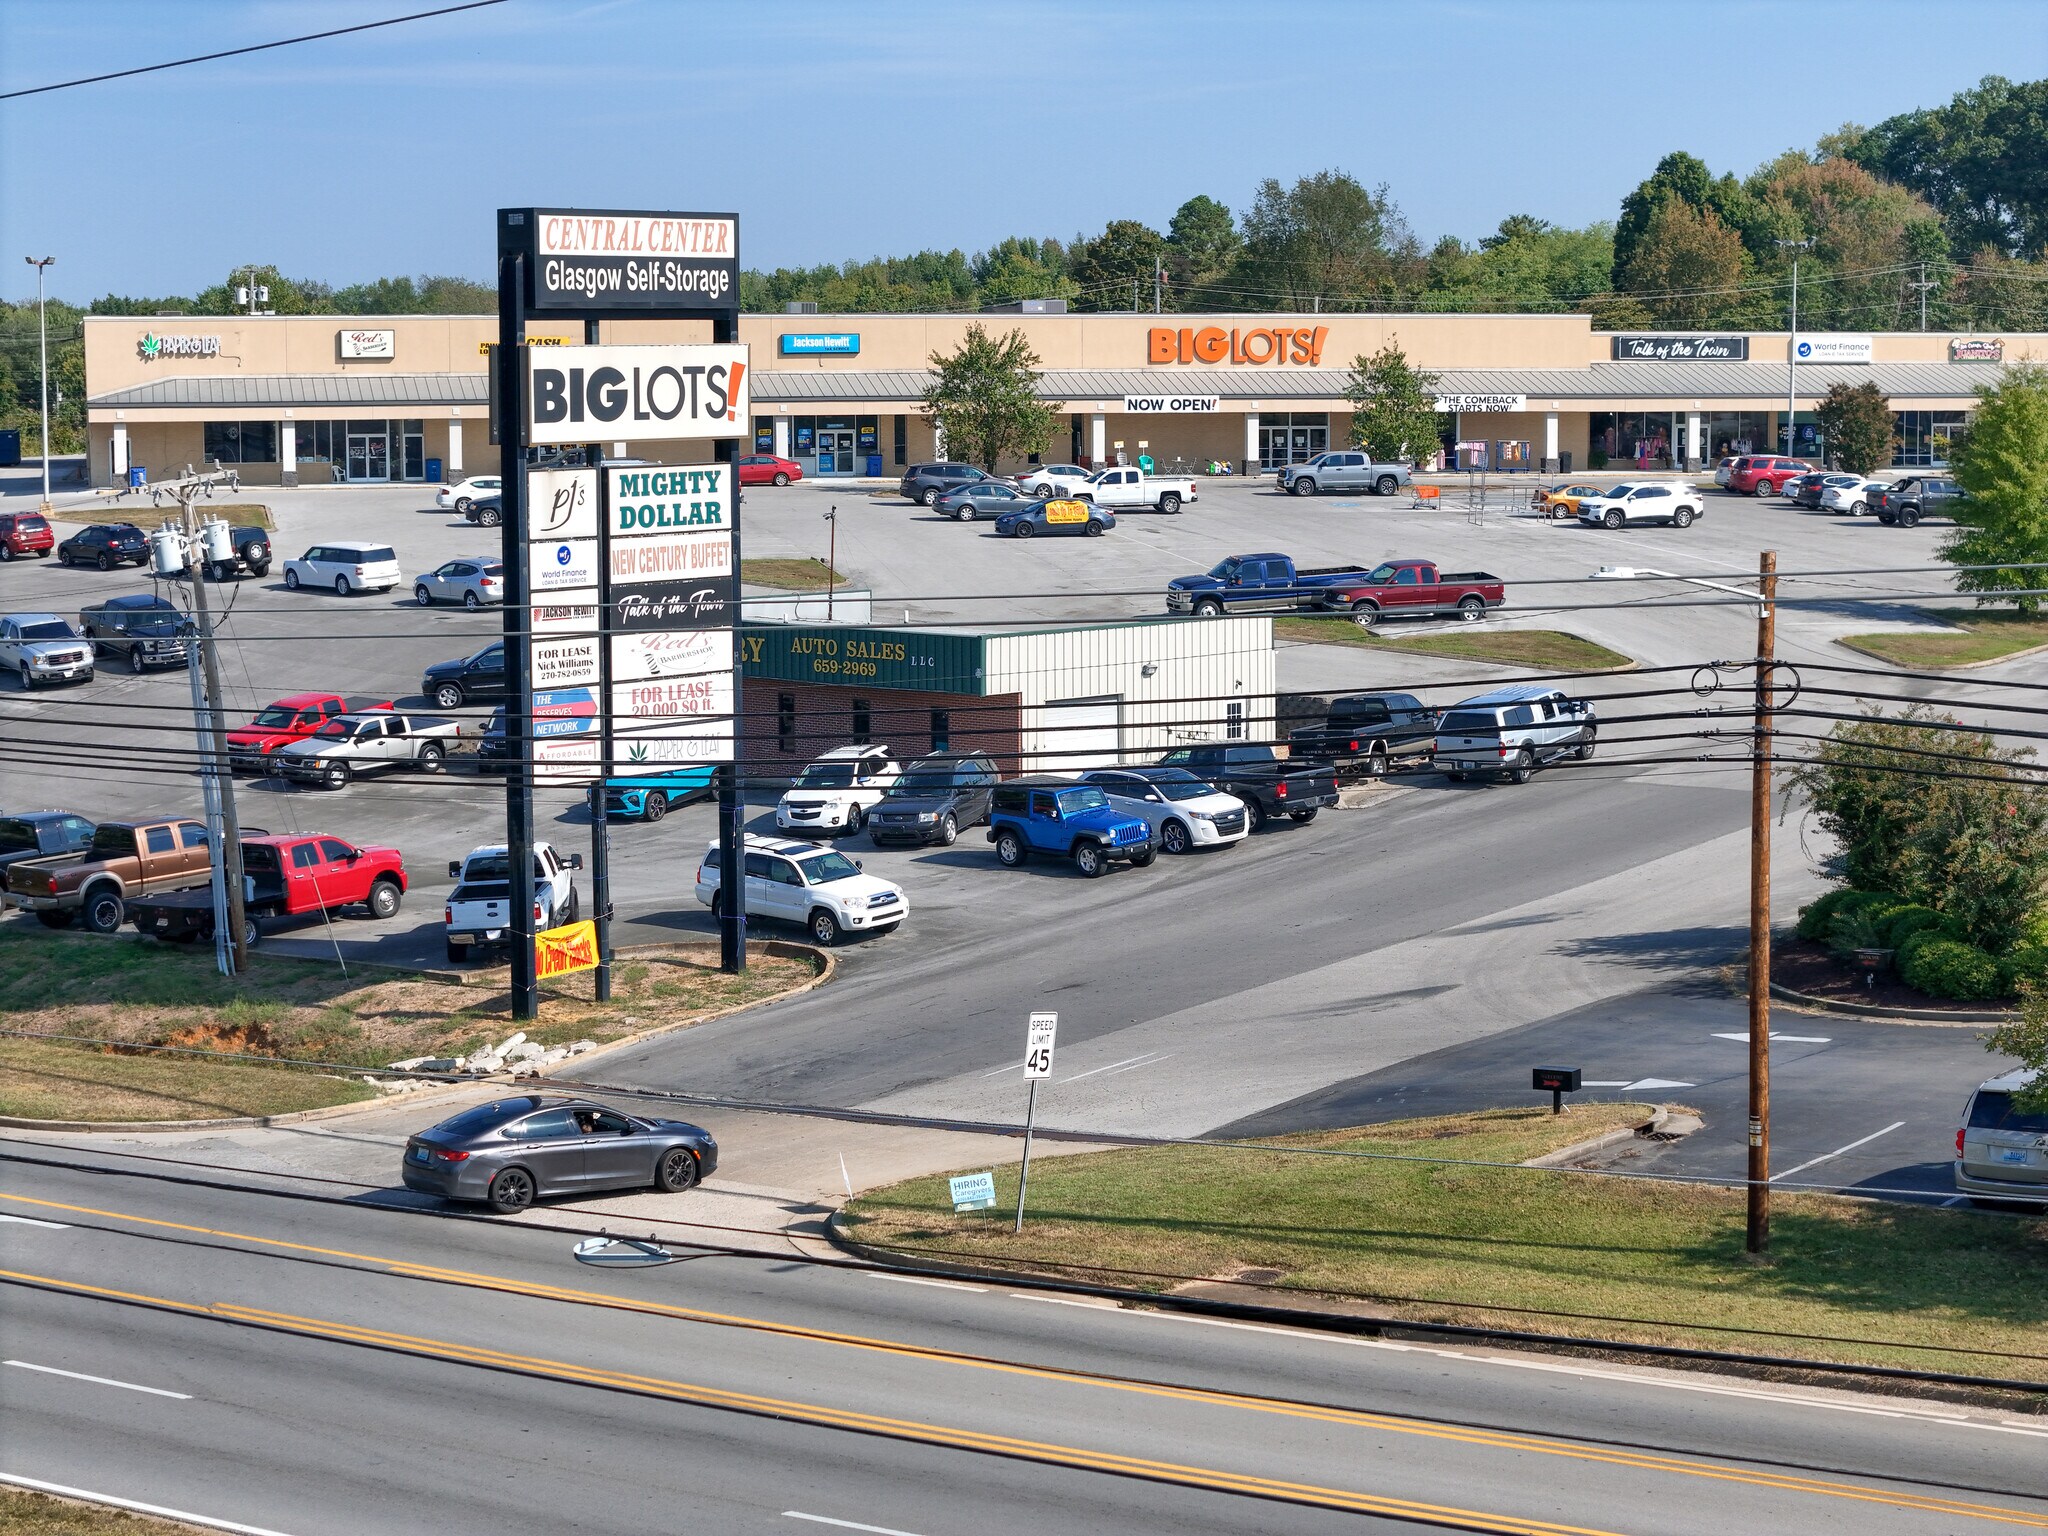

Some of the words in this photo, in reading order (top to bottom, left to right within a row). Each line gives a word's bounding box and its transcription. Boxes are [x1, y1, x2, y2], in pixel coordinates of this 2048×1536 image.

[546, 218, 643, 252] CENTRAL
[648, 220, 728, 253] CENTER
[545, 260, 622, 298] Glasgow
[626, 261, 729, 299] Self-Storage
[351, 332, 384, 343] Red's
[793, 336, 824, 347] Jackson
[825, 336, 850, 347] Hewitt
[1150, 327, 1229, 363] BIG
[1232, 326, 1330, 364] LOTS!
[1628, 339, 1655, 356] Talk
[1656, 345, 1669, 359] of
[1671, 342, 1693, 357] the
[1694, 338, 1730, 357] Town
[533, 366, 628, 424] BIG
[633, 361, 747, 422] LOTS!
[1444, 395, 1462, 404] THE
[1464, 395, 1518, 404] COMEBACK
[1127, 398, 1165, 411] NOW
[1170, 398, 1218, 411] OPEN!
[1448, 404, 1483, 412] STARTS
[1485, 404, 1512, 412] NOW!
[619, 470, 722, 498] MIGHTY
[619, 501, 722, 529] DOLLAR
[612, 549, 636, 576] NEW
[639, 544, 688, 574] CENTURY
[691, 541, 730, 569] BUFFET
[542, 570, 561, 578] World
[562, 568, 587, 578] Finance
[542, 606, 572, 618] JACKSON
[573, 605, 595, 616] HEWITT
[618, 594, 650, 625] Talk
[652, 597, 667, 619] of
[669, 595, 688, 615] the
[689, 588, 725, 619] Town
[641, 631, 712, 651] Red's
[791, 637, 838, 657] AUTO
[846, 639, 905, 661] SALES
[538, 648, 560, 659] FOR
[562, 646, 592, 657] LEASE
[660, 645, 714, 664] BARBERSHOP
[537, 660, 556, 671] Nick
[558, 658, 594, 669] Williams
[813, 658, 877, 677] 659-2969
[541, 668, 591, 680] 270-782-0859
[536, 694, 552, 705] THE
[632, 686, 662, 706] FOR
[668, 681, 713, 701] LEASE
[632, 702, 678, 718] 20,000
[681, 700, 698, 714] SQ
[702, 698, 715, 711] ft.
[536, 720, 579, 735] NETWORK
[539, 749, 593, 760] AFFORDABLE
[653, 739, 683, 761] PAPER
[1031, 1020, 1054, 1030] SPEED
[1031, 1034, 1050, 1045] LIMIT
[1027, 1049, 1050, 1072] 45
[953, 1178, 988, 1191] HIRING
[954, 1187, 992, 1197] Caregivers
